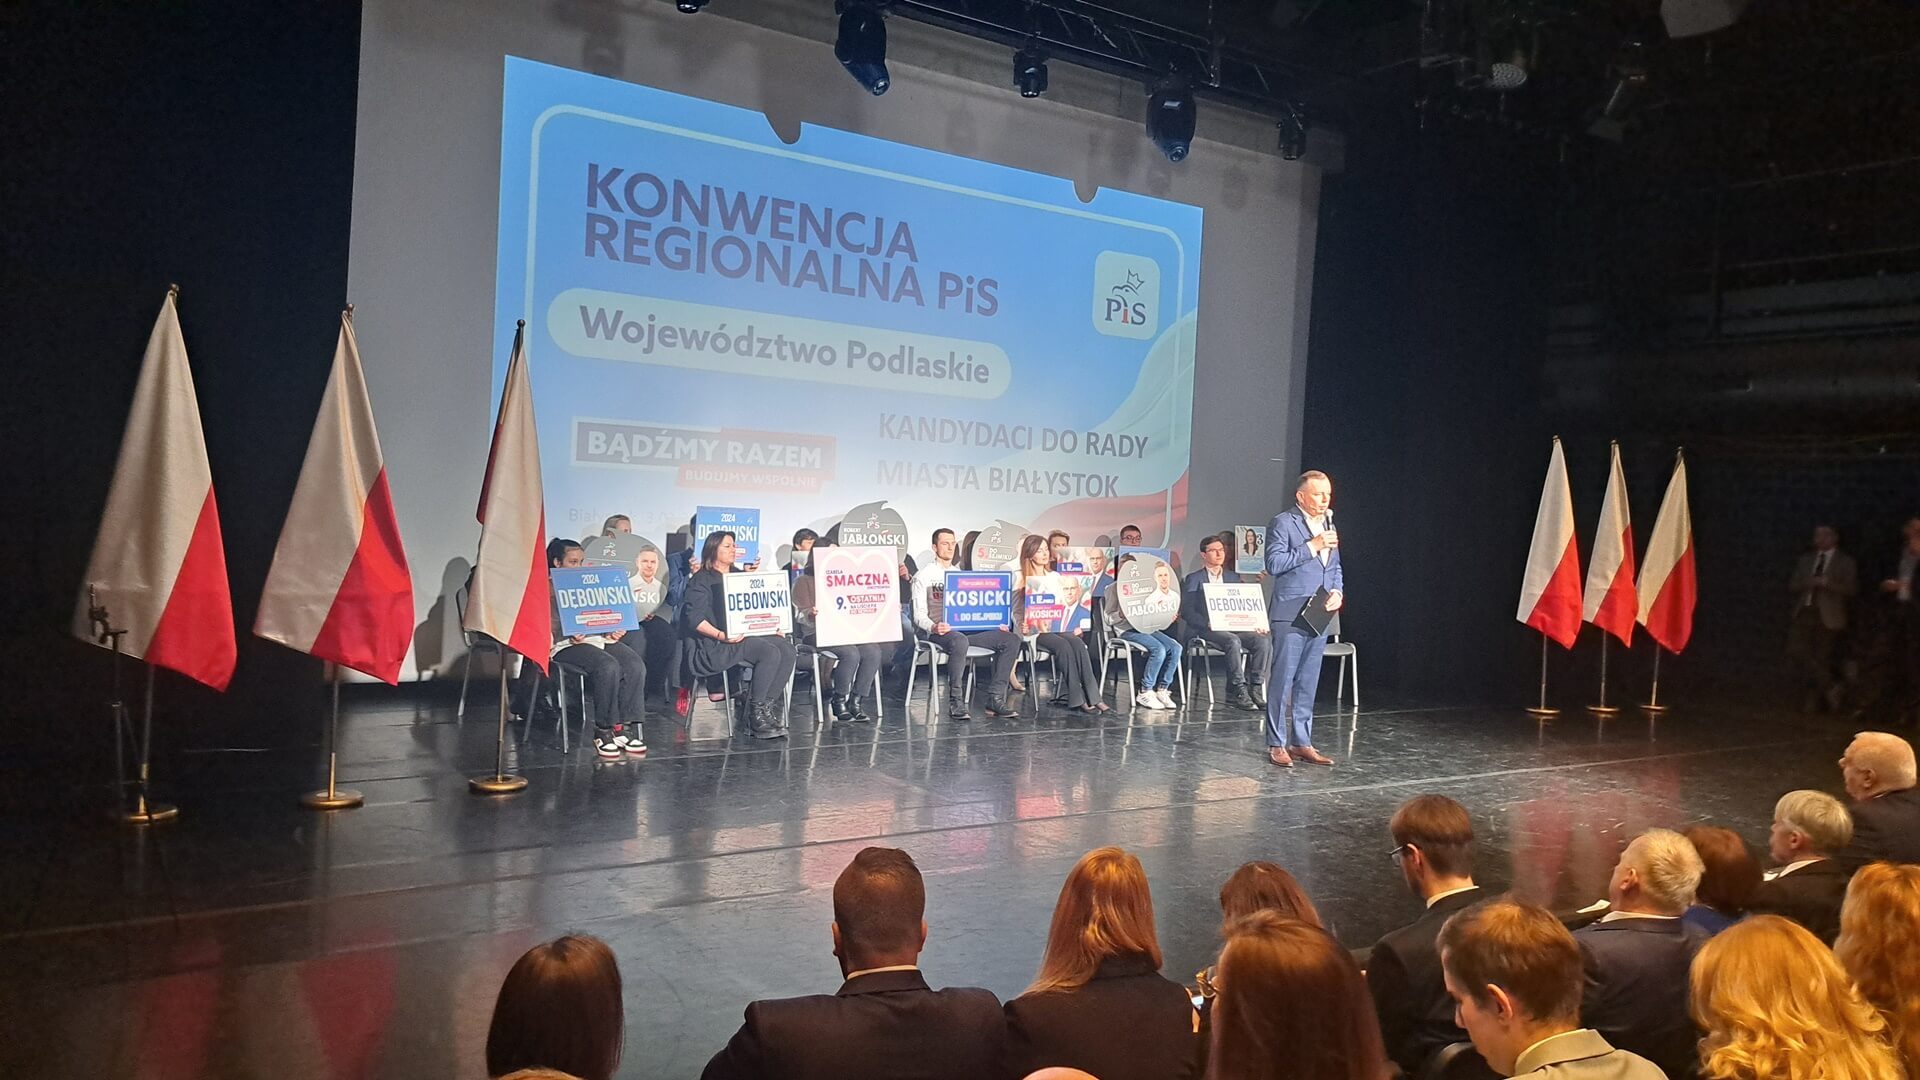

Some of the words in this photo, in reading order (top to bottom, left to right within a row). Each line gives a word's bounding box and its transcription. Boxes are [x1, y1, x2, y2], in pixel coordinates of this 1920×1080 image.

[587, 163, 918, 262] KONWENCJA
[585, 212, 925, 307] REGIONALNA
[938, 271, 998, 316] PiS
[1105, 298, 1146, 325] PiS
[580, 305, 837, 366] Województwo
[847, 340, 989, 383] Podlaskie
[879, 413, 1032, 450] KANDYDACI
[1041, 427, 1077, 453] DO
[1086, 432, 1148, 458] RADY
[587, 430, 719, 463] BĄDŹMY
[727, 441, 822, 469] RAZEM
[685, 469, 748, 483] BUDUJMY
[877, 459, 980, 490] MIASTA
[989, 467, 1120, 498] BIAŁYSTOK
[721, 513, 736, 522] 2024
[1256, 533, 1264, 546] 3
[581, 574, 600, 585] 2024
[749, 578, 765, 589] 2024
[826, 573, 890, 588] SMACZNA
[557, 586, 632, 609] DĘBOWSKI
[728, 590, 788, 612] DĘBOWSKI
[836, 596, 847, 610] 9.
[945, 590, 1010, 606] KOSICKI
[1029, 609, 1062, 618] KOSICKI
